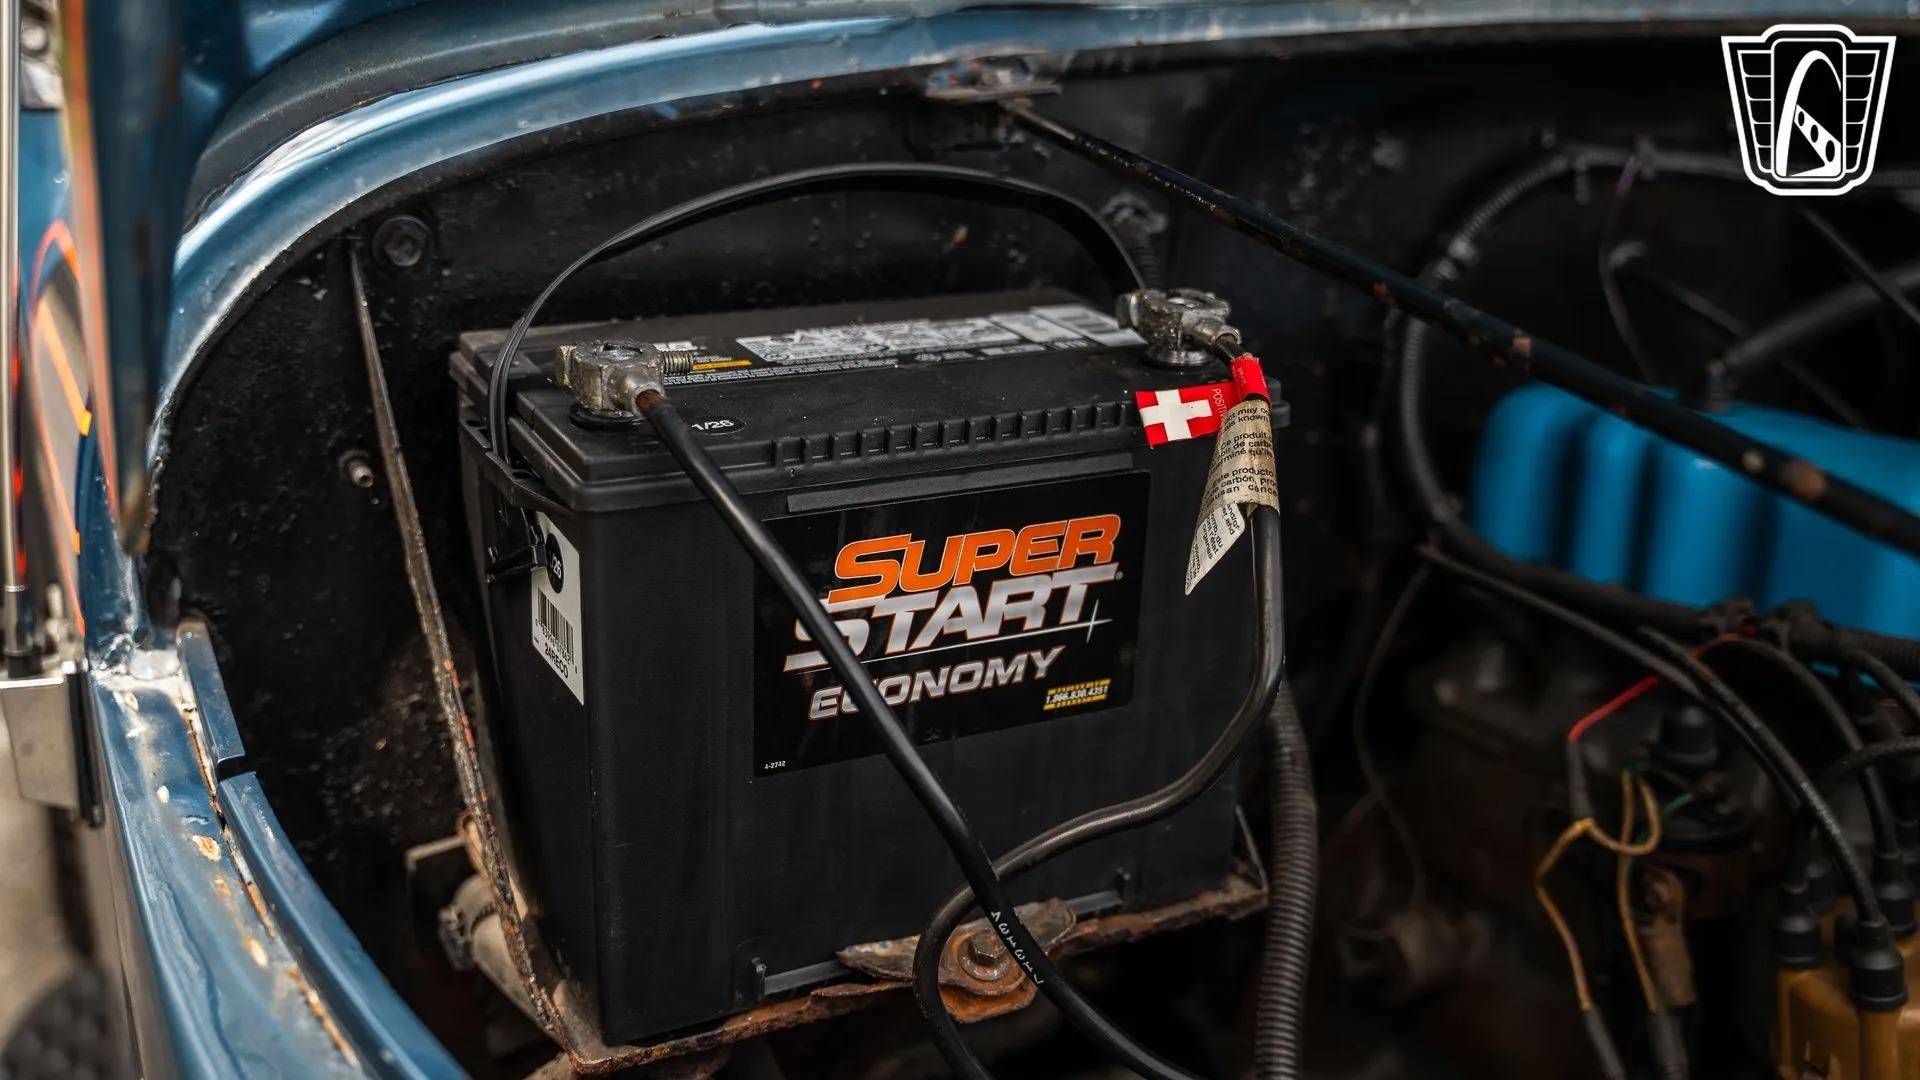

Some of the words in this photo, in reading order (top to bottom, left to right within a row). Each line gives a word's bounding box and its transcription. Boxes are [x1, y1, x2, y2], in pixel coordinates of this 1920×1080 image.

[1237, 407, 1258, 416] may
[1237, 414, 1269, 423] known
[1233, 432, 1267, 444] produit
[1233, 441, 1246, 450] de
[1231, 467, 1274, 477] producto
[828, 514, 1121, 604] SUPER
[783, 562, 1120, 672] START
